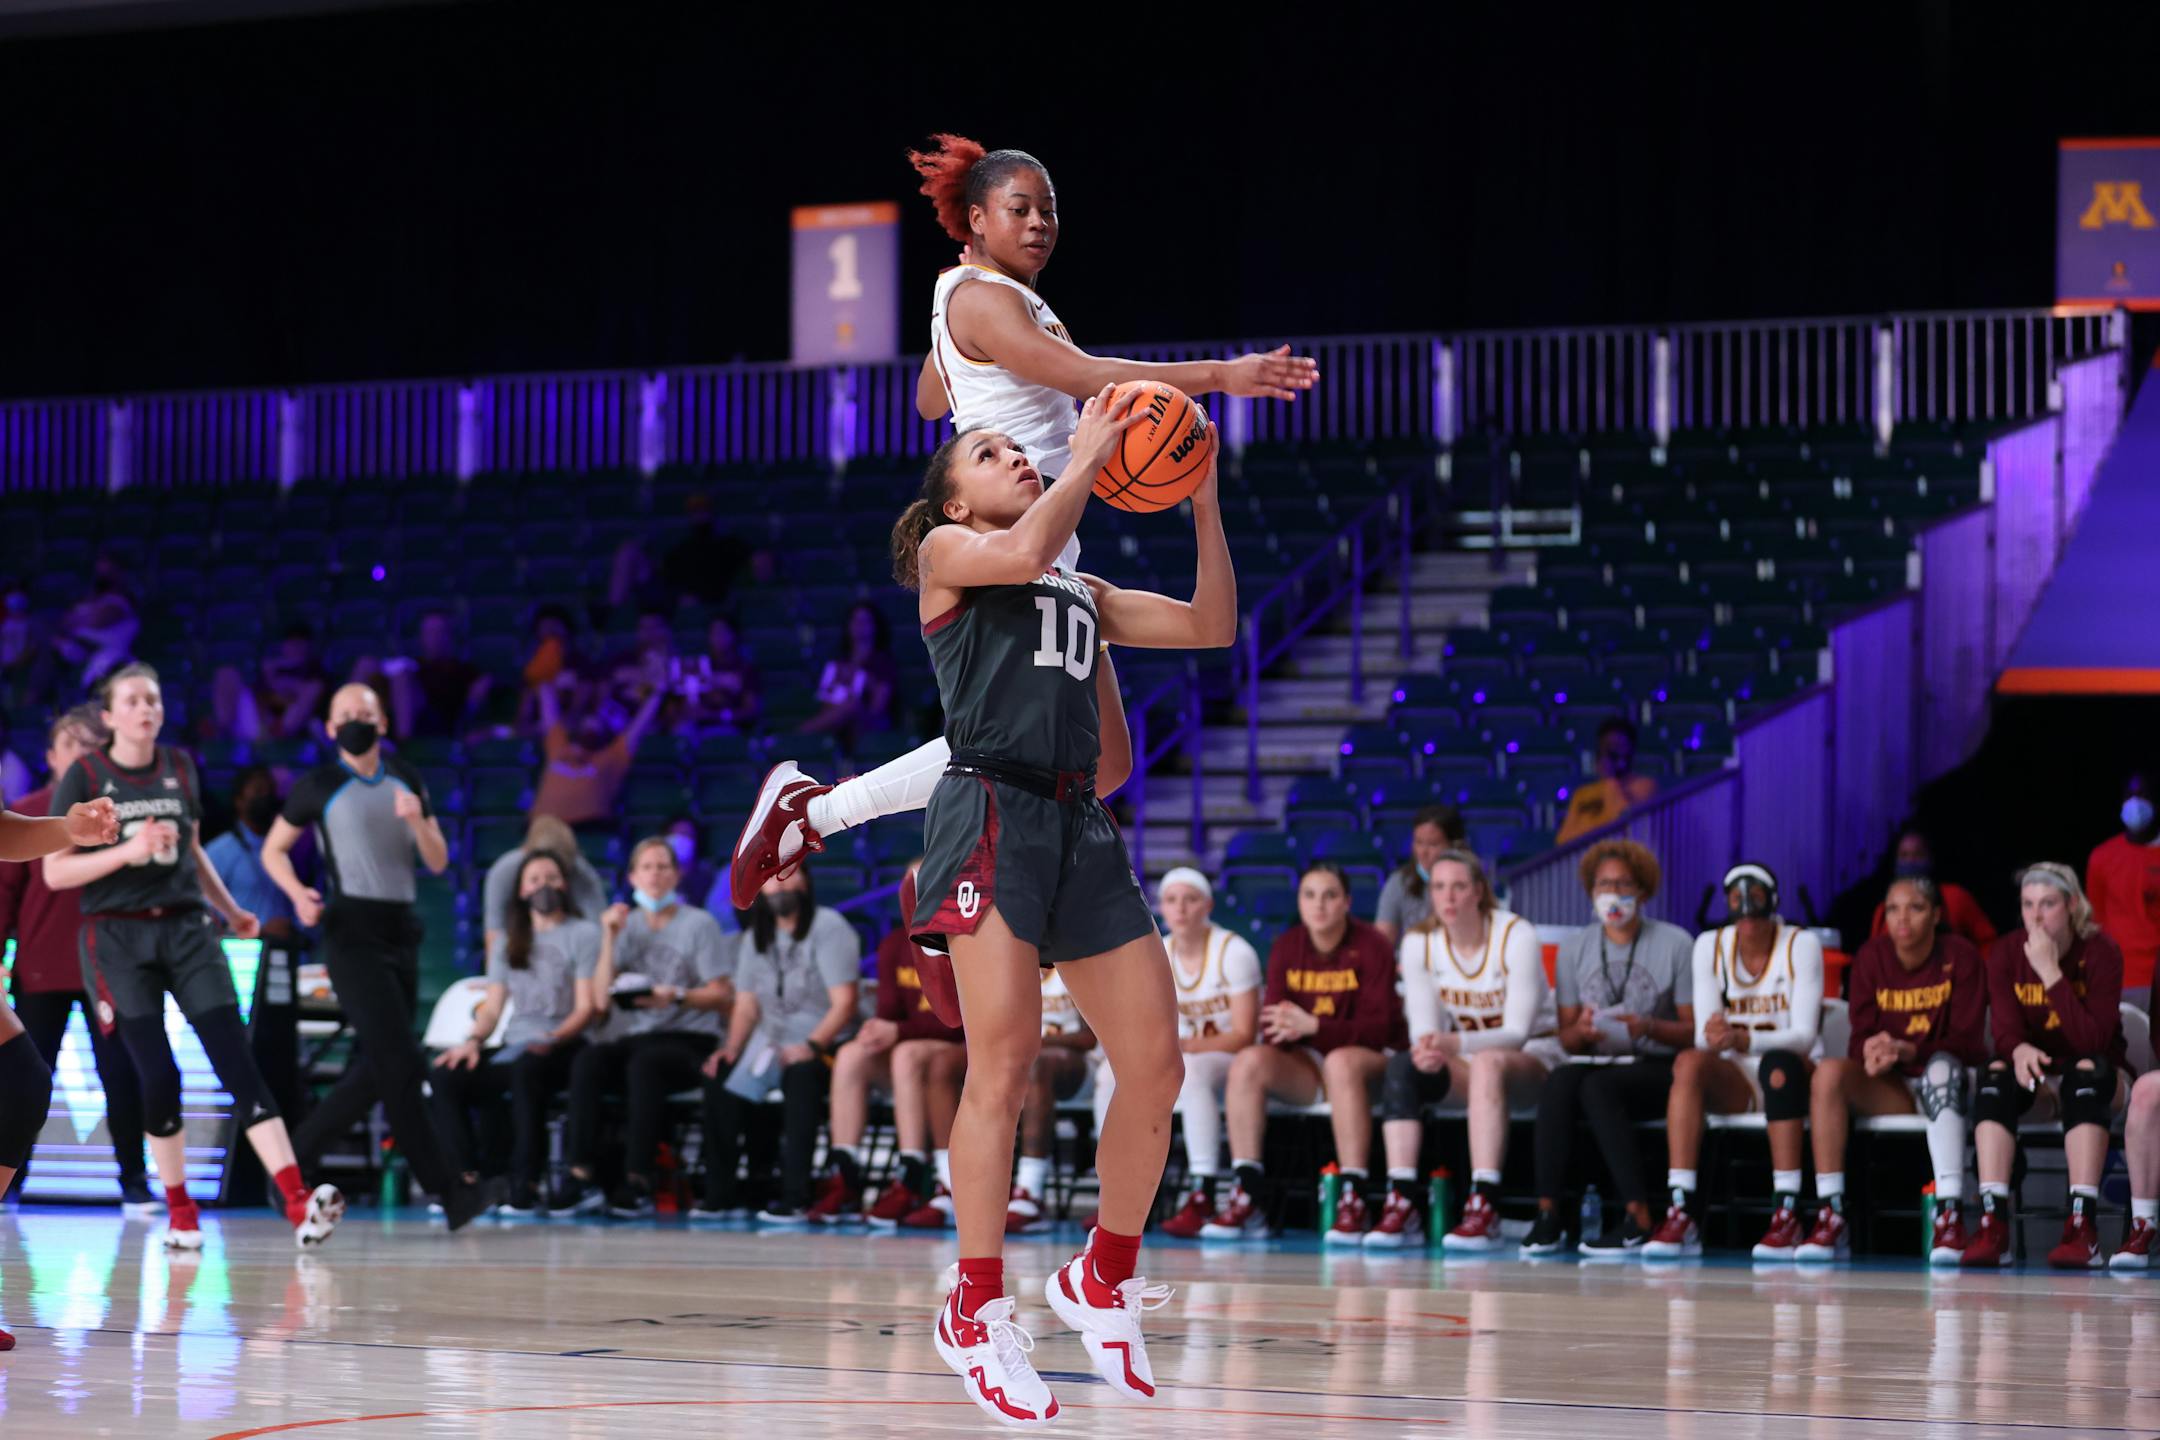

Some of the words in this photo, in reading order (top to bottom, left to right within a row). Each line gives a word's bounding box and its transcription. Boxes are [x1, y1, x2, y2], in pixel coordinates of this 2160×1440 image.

[828, 233, 862, 300] 1
[1033, 596, 1096, 681] 10
[957, 881, 980, 918] OU
[1876, 980, 1951, 1011] MINNESOT
